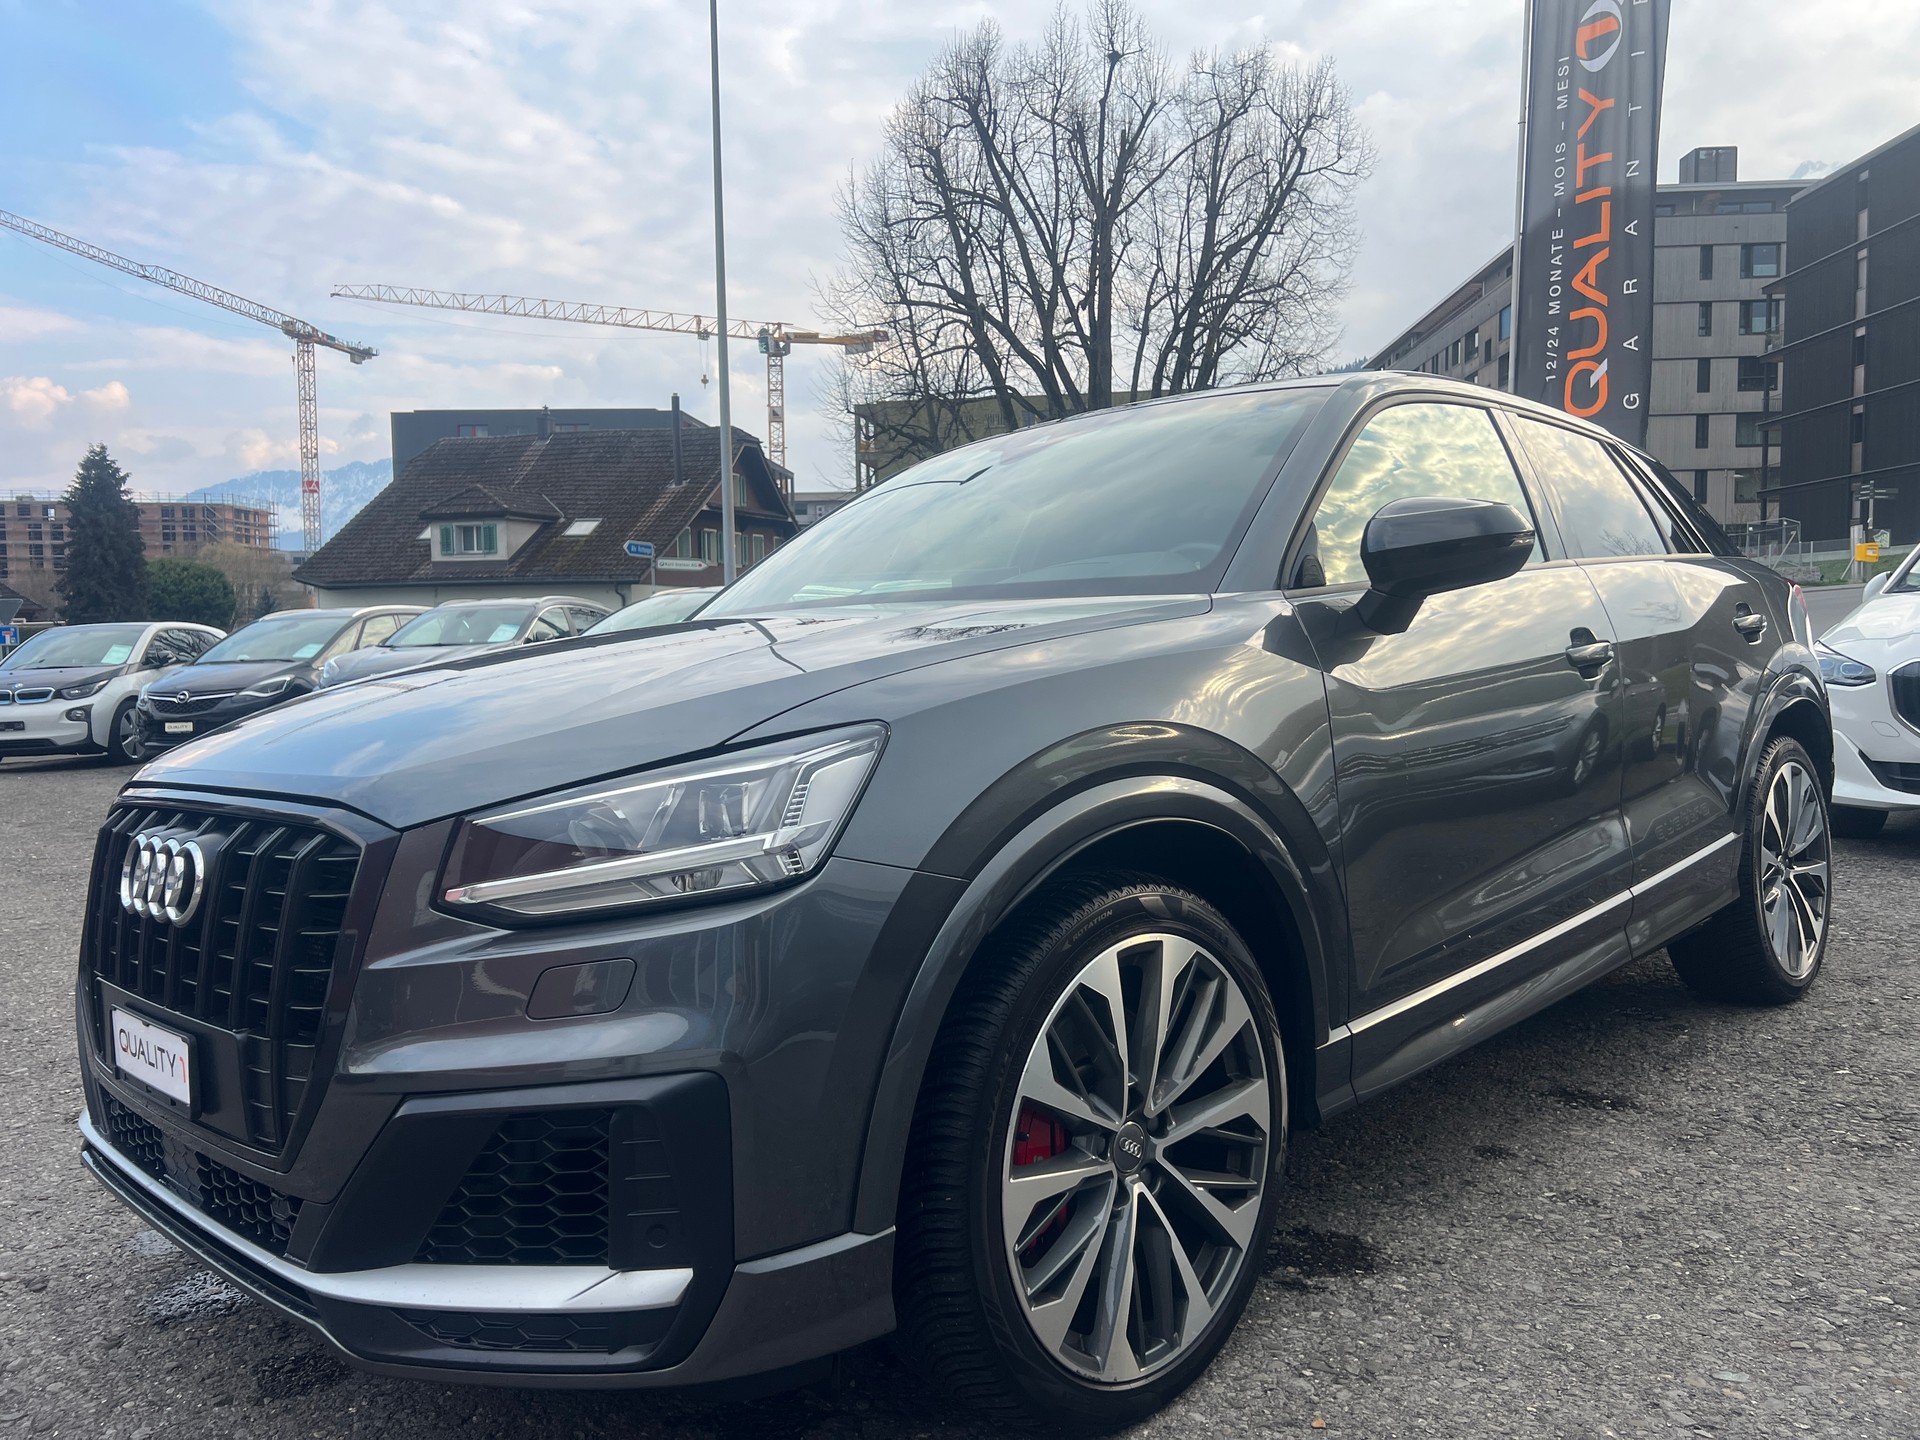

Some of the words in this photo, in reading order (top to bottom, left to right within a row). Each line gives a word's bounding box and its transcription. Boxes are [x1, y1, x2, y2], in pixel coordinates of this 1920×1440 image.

[1556, 56, 1570, 110] MESI
[1554, 142, 1566, 197] MOIS
[1548, 228, 1564, 315] MONATE
[1564, 87, 1615, 418] QUALITY
[1546, 326, 1560, 381] 12/24
[1072, 909, 1113, 942] ROTATION
